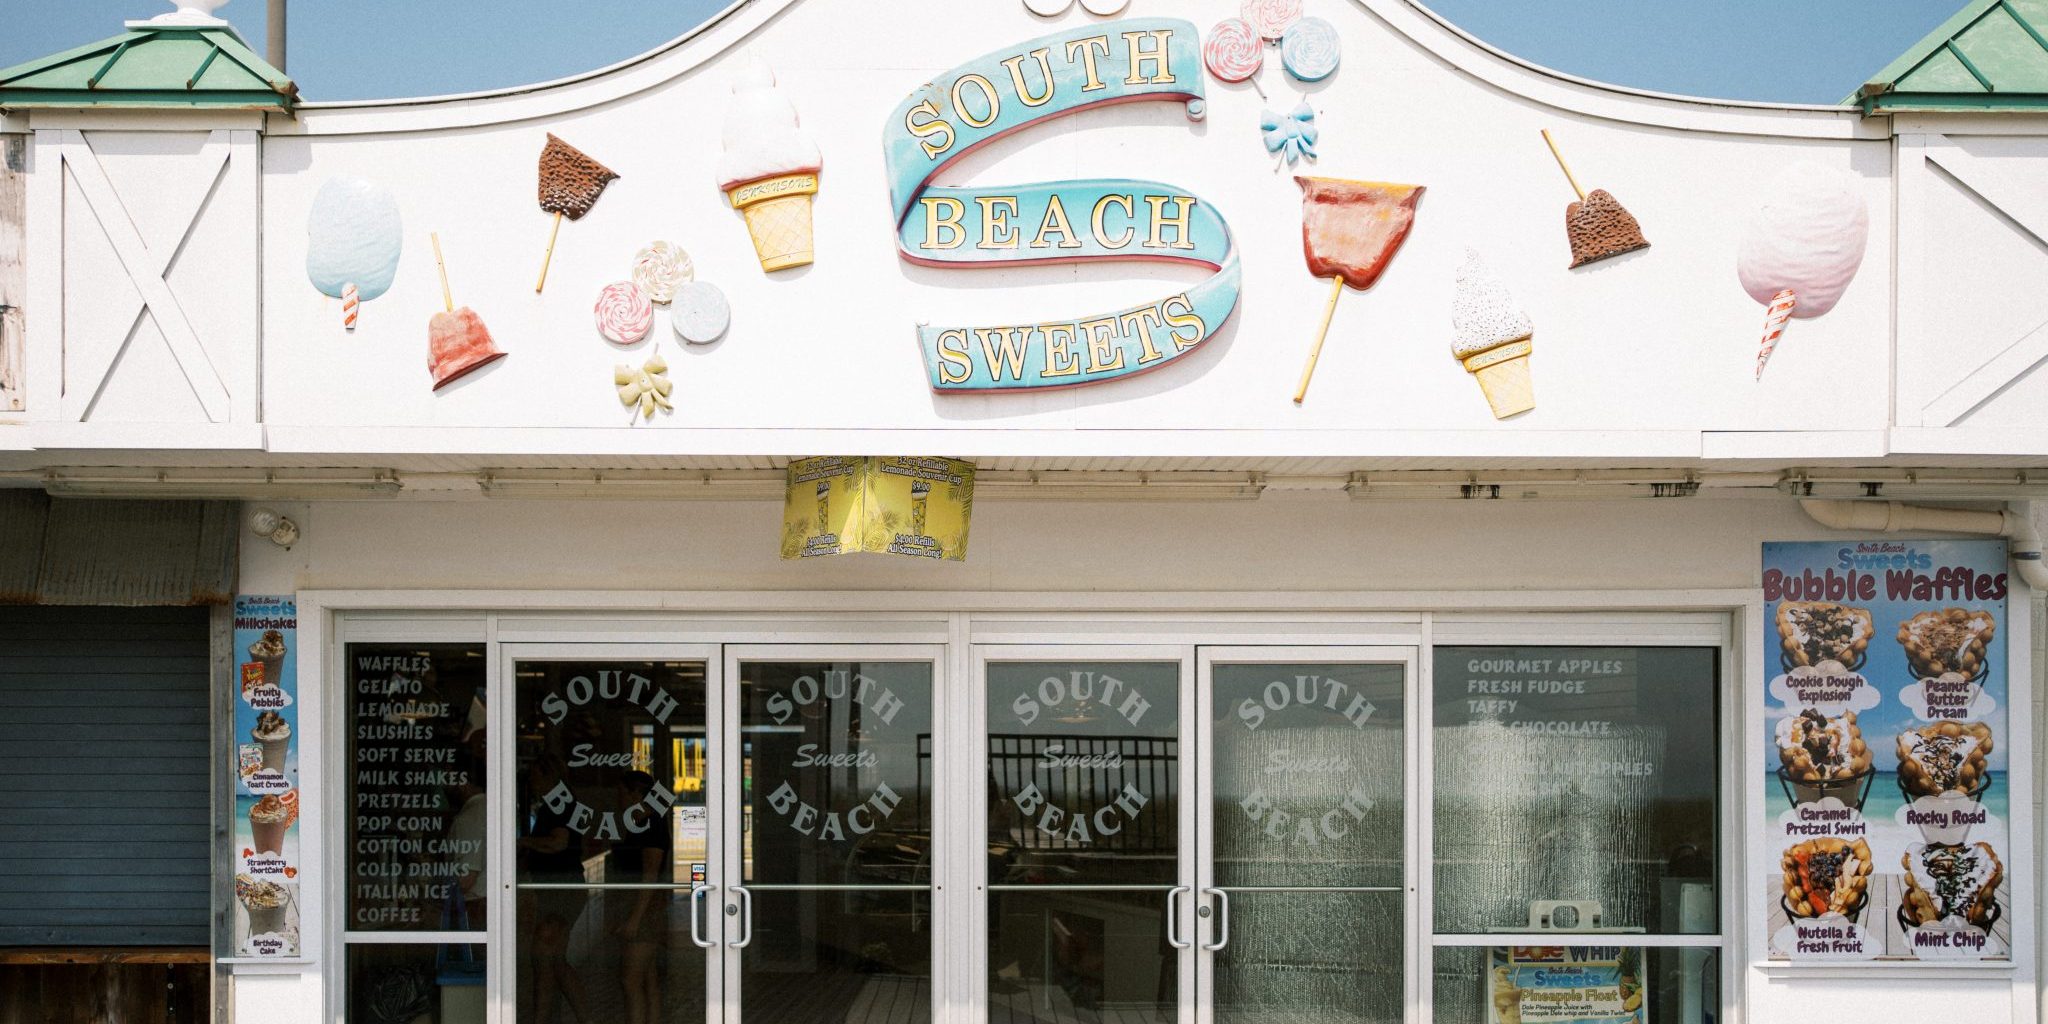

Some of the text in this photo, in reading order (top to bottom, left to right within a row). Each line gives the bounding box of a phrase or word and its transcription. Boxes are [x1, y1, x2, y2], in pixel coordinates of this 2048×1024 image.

[905, 30, 1175, 160] SOUTH
[919, 195, 1197, 249] BEACH
[938, 292, 1206, 384] SWEETS
[917, 458, 948, 470] Refillable
[882, 463, 962, 484] Lemonade Souvenir Cup
[912, 481, 930, 490] $9.00
[896, 534, 934, 546] $4.00 Refills
[1856, 543, 1904, 552] South Beach
[888, 543, 942, 559] All Season Long!
[1838, 548, 1932, 569] Sweets
[1763, 566, 2007, 601] Bubble Waffles
[236, 601, 296, 615] Sweets
[235, 617, 297, 629] Milkshakes
[358, 656, 430, 671] WAFFLES
[1467, 659, 1622, 674] GOURMET APPLES
[358, 679, 422, 694] GELATO
[1467, 680, 1585, 694] FRESH FUDGE
[1786, 676, 1863, 691] Cookie Dough
[1926, 680, 1969, 693] Peanut
[254, 687, 281, 698] Fruity
[541, 670, 680, 725] SOUTH
[766, 670, 904, 725] SOUTH
[1012, 671, 1151, 727] SOUTH
[1798, 689, 1851, 704] Explosion
[1927, 693, 1968, 706] Butter
[251, 698, 284, 707] Pebbles
[358, 702, 450, 717] LEMONADE
[1238, 675, 1376, 730] SOUTH
[1467, 700, 1518, 714] TAFFY
[1927, 706, 1967, 719] Dream
[358, 725, 433, 740] SLUSHIES
[1510, 721, 1611, 734] CHOCOLATE
[357, 748, 456, 763] SOFT SERVE
[792, 743, 879, 768] Sweets
[1039, 745, 1126, 769] Sweets
[357, 771, 468, 786] MILK SHAKES
[358, 793, 440, 808] PRETZELS
[542, 780, 677, 840] BEACH
[766, 780, 902, 841] BEACH
[1012, 781, 1149, 842] BEACH
[1239, 786, 1376, 846] BEACH
[1801, 808, 1850, 820] Caramel
[358, 816, 442, 831] POP CORN
[1906, 810, 1986, 828] Rocky Road
[1786, 822, 1866, 835] Pretzel Swirl
[357, 839, 482, 854] COTTON CANDY
[247, 859, 286, 867] Strawberry
[250, 866, 283, 874] ShortCake
[357, 863, 470, 877] COLD DRINKS
[358, 885, 450, 899] ITALIAN ICE
[357, 908, 420, 922] COFFEE
[1798, 927, 1856, 939] Nutella &
[253, 939, 282, 948] Birthday
[1797, 941, 1863, 953] Fresh Fruit
[1915, 932, 1986, 951] Mint Chip
[1569, 946, 1620, 962] WHIP
[1534, 971, 1601, 986] Sweets
[1521, 989, 1618, 1004] Pineapple Float
